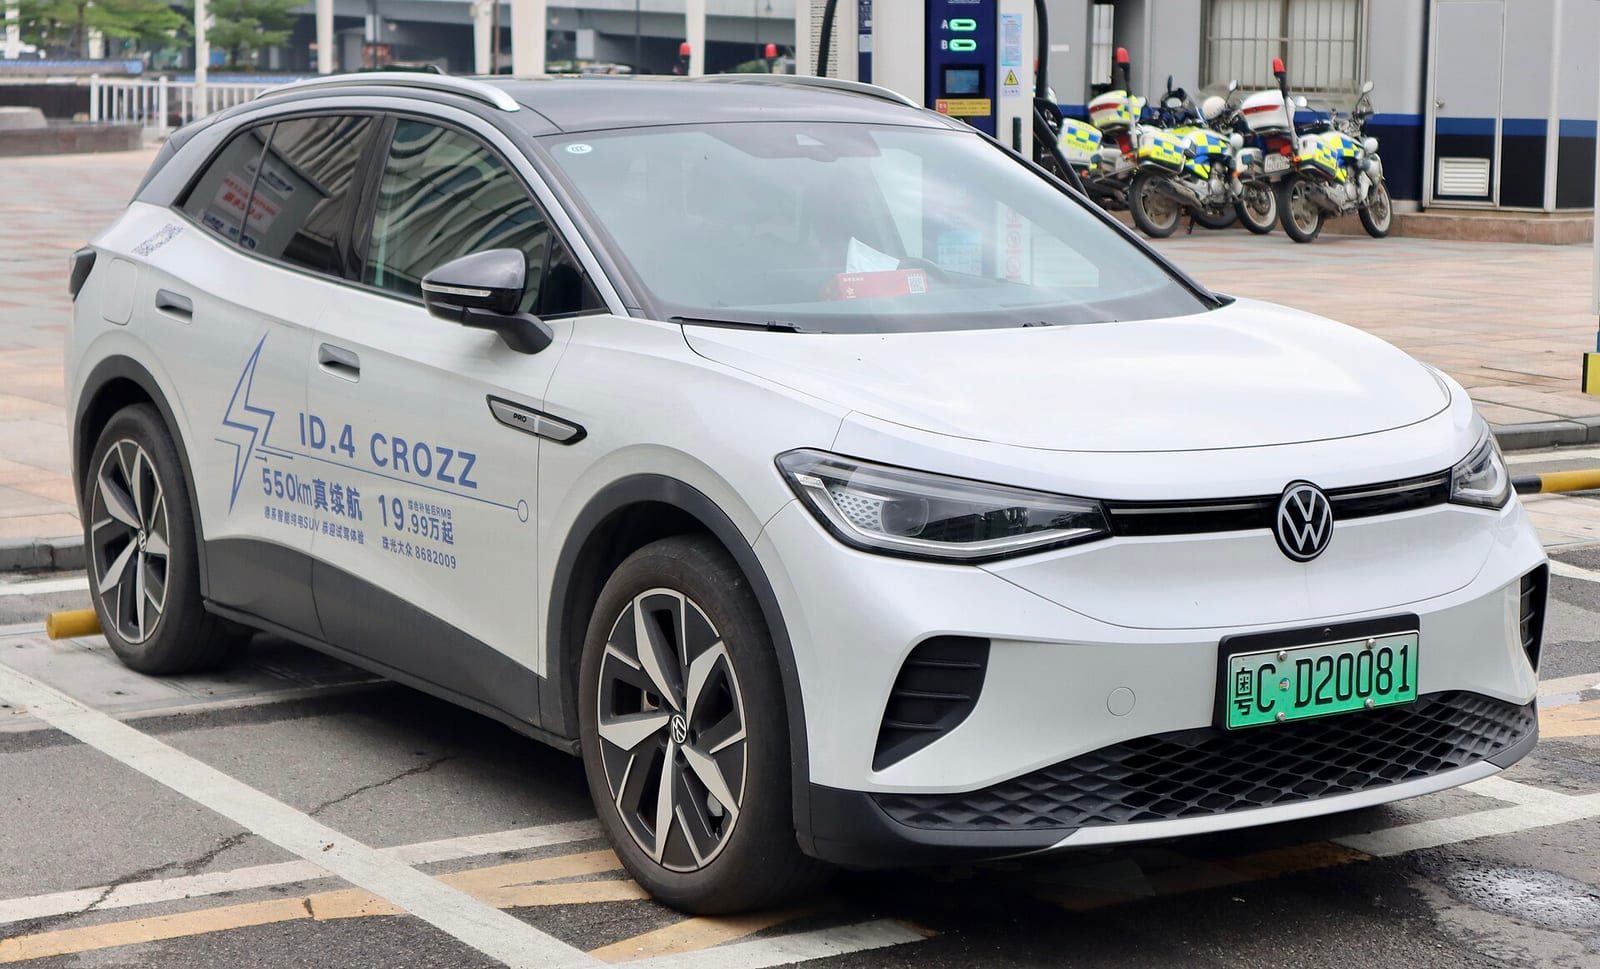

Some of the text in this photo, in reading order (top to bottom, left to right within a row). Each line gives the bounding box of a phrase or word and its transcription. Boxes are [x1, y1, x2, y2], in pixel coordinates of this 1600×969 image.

[941, 19, 949, 30] A
[941, 39, 948, 50] B
[513, 412, 527, 423] PRO
[299, 412, 478, 489] ID.4 CROZZ
[262, 467, 363, 521] 550km真续航
[1278, 485, 1333, 559] VW
[382, 536, 457, 569] 珠光大众 8682009
